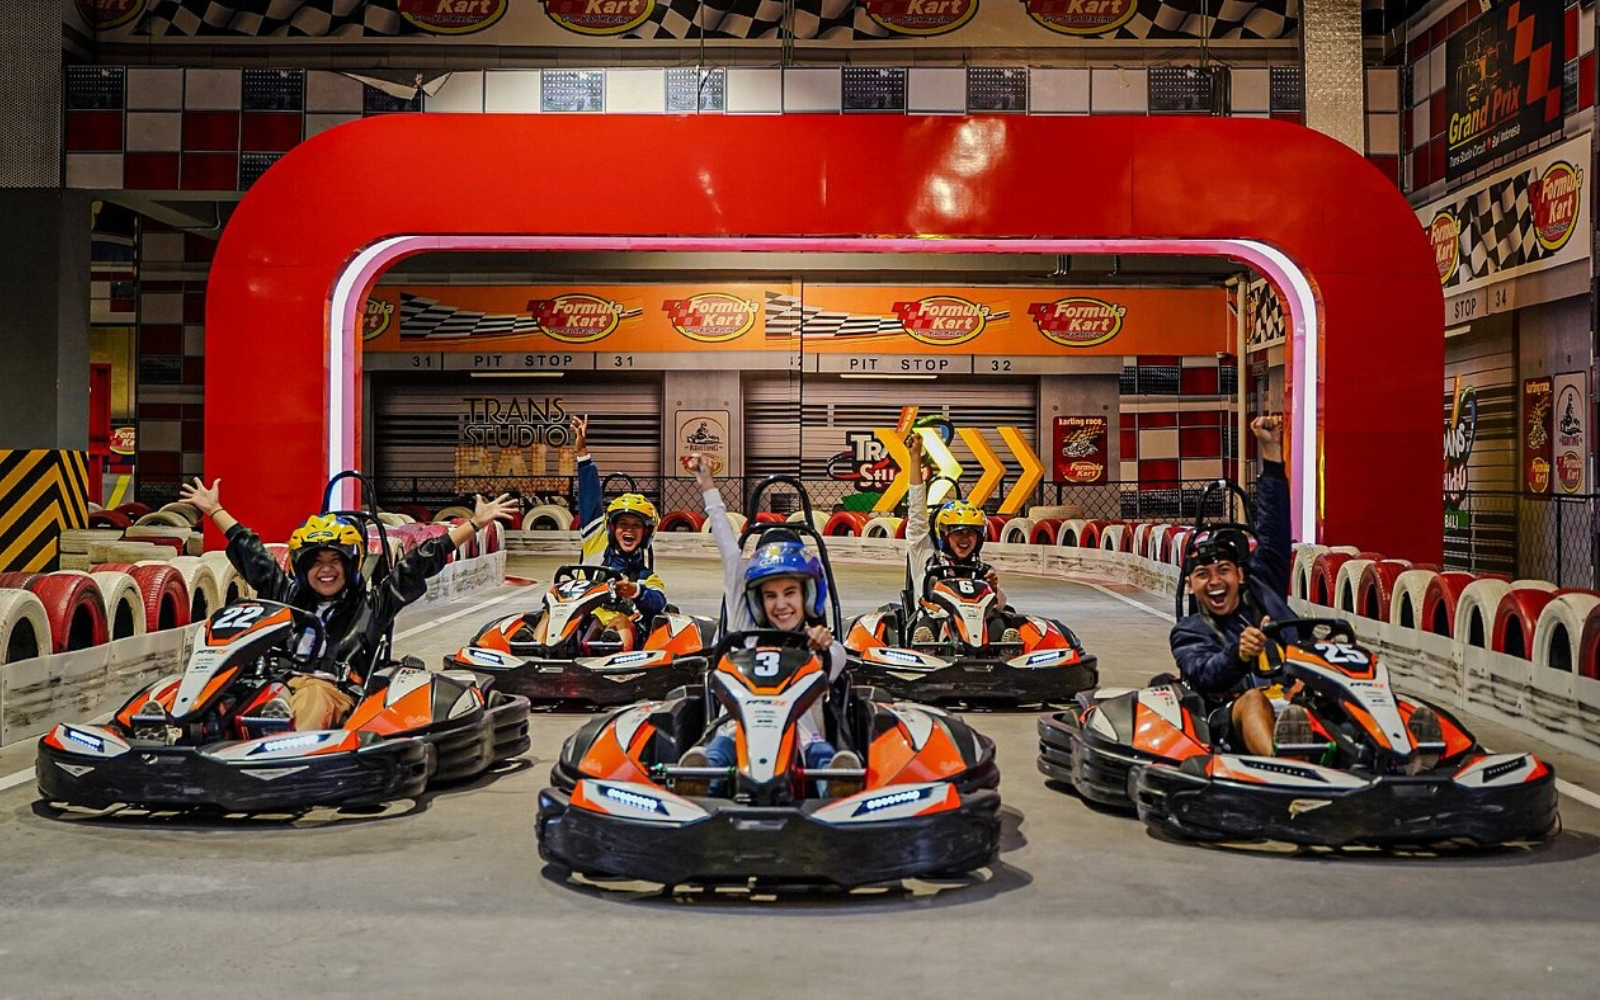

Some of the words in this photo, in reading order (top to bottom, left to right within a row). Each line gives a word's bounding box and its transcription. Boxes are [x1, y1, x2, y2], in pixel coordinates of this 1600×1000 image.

[437, 0, 491, 13] Kart
[586, 0, 639, 14] Kart
[907, 0, 961, 14] Kart
[1067, 0, 1121, 14] Kart
[1449, 95, 1489, 144] Grand
[1492, 84, 1520, 123] Prix
[1541, 164, 1583, 203] Formula
[1549, 194, 1573, 224] Kart
[552, 300, 624, 314] Formula
[687, 299, 759, 314] Formula
[918, 301, 990, 316] Formula
[1454, 297, 1477, 319] STOP
[1495, 287, 1507, 308] 34
[1054, 304, 1127, 317] Formula
[566, 315, 607, 327] Kart
[702, 314, 743, 327] Kart
[932, 317, 973, 330] Kart
[1069, 318, 1110, 331] Kart
[412, 355, 431, 367] 31
[474, 355, 502, 367] PIT
[525, 355, 573, 367] STOP
[614, 356, 633, 367] 31
[850, 358, 878, 370] PIT
[901, 359, 949, 370] STOP
[991, 360, 1011, 371] 32
[462, 397, 566, 424] TRANS
[464, 425, 568, 448] STUDIO
[959, 580, 975, 594] 6
[212, 606, 264, 630] 22
[1314, 643, 1369, 665] 25
[754, 651, 780, 677] 3
